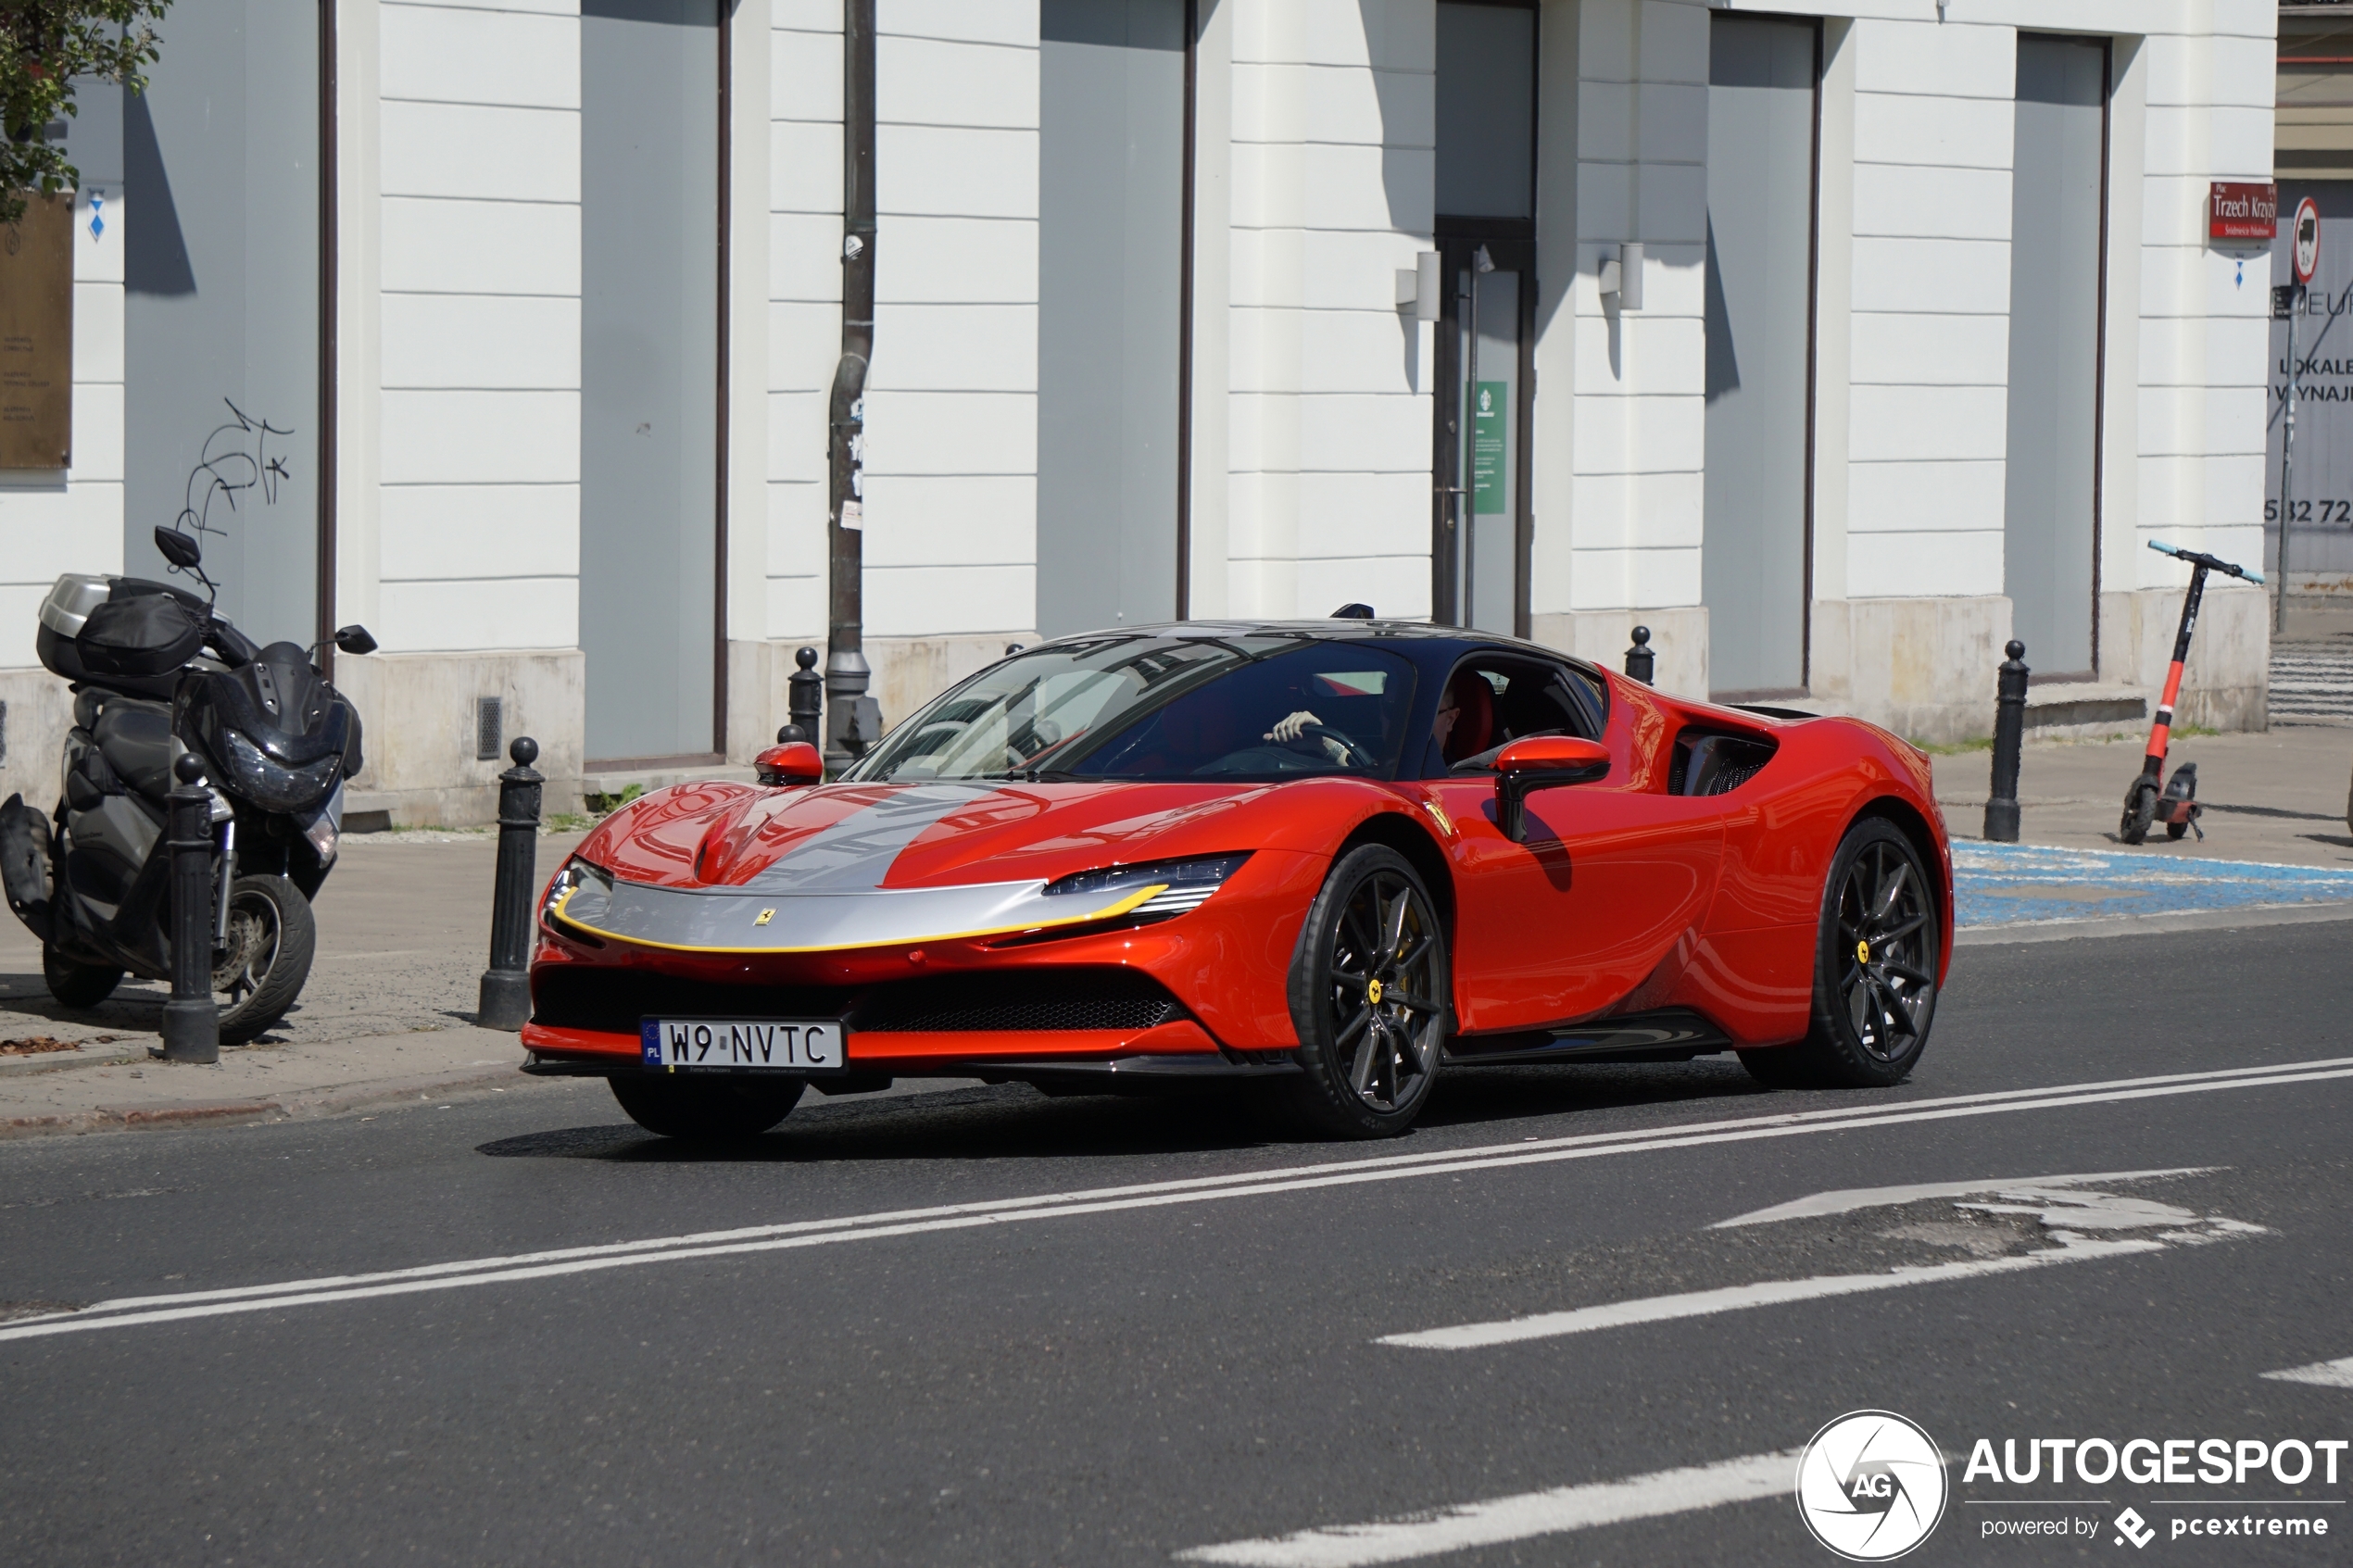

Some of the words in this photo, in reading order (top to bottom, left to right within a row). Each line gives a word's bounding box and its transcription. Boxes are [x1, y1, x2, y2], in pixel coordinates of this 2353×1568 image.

[2213, 194, 2248, 218] Trzech
[2309, 293, 2353, 316] EU
[2274, 385, 2353, 402] WYNAJ
[648, 1047, 661, 1058] PL
[670, 1023, 712, 1062] W9
[731, 1023, 827, 1063] NVTC
